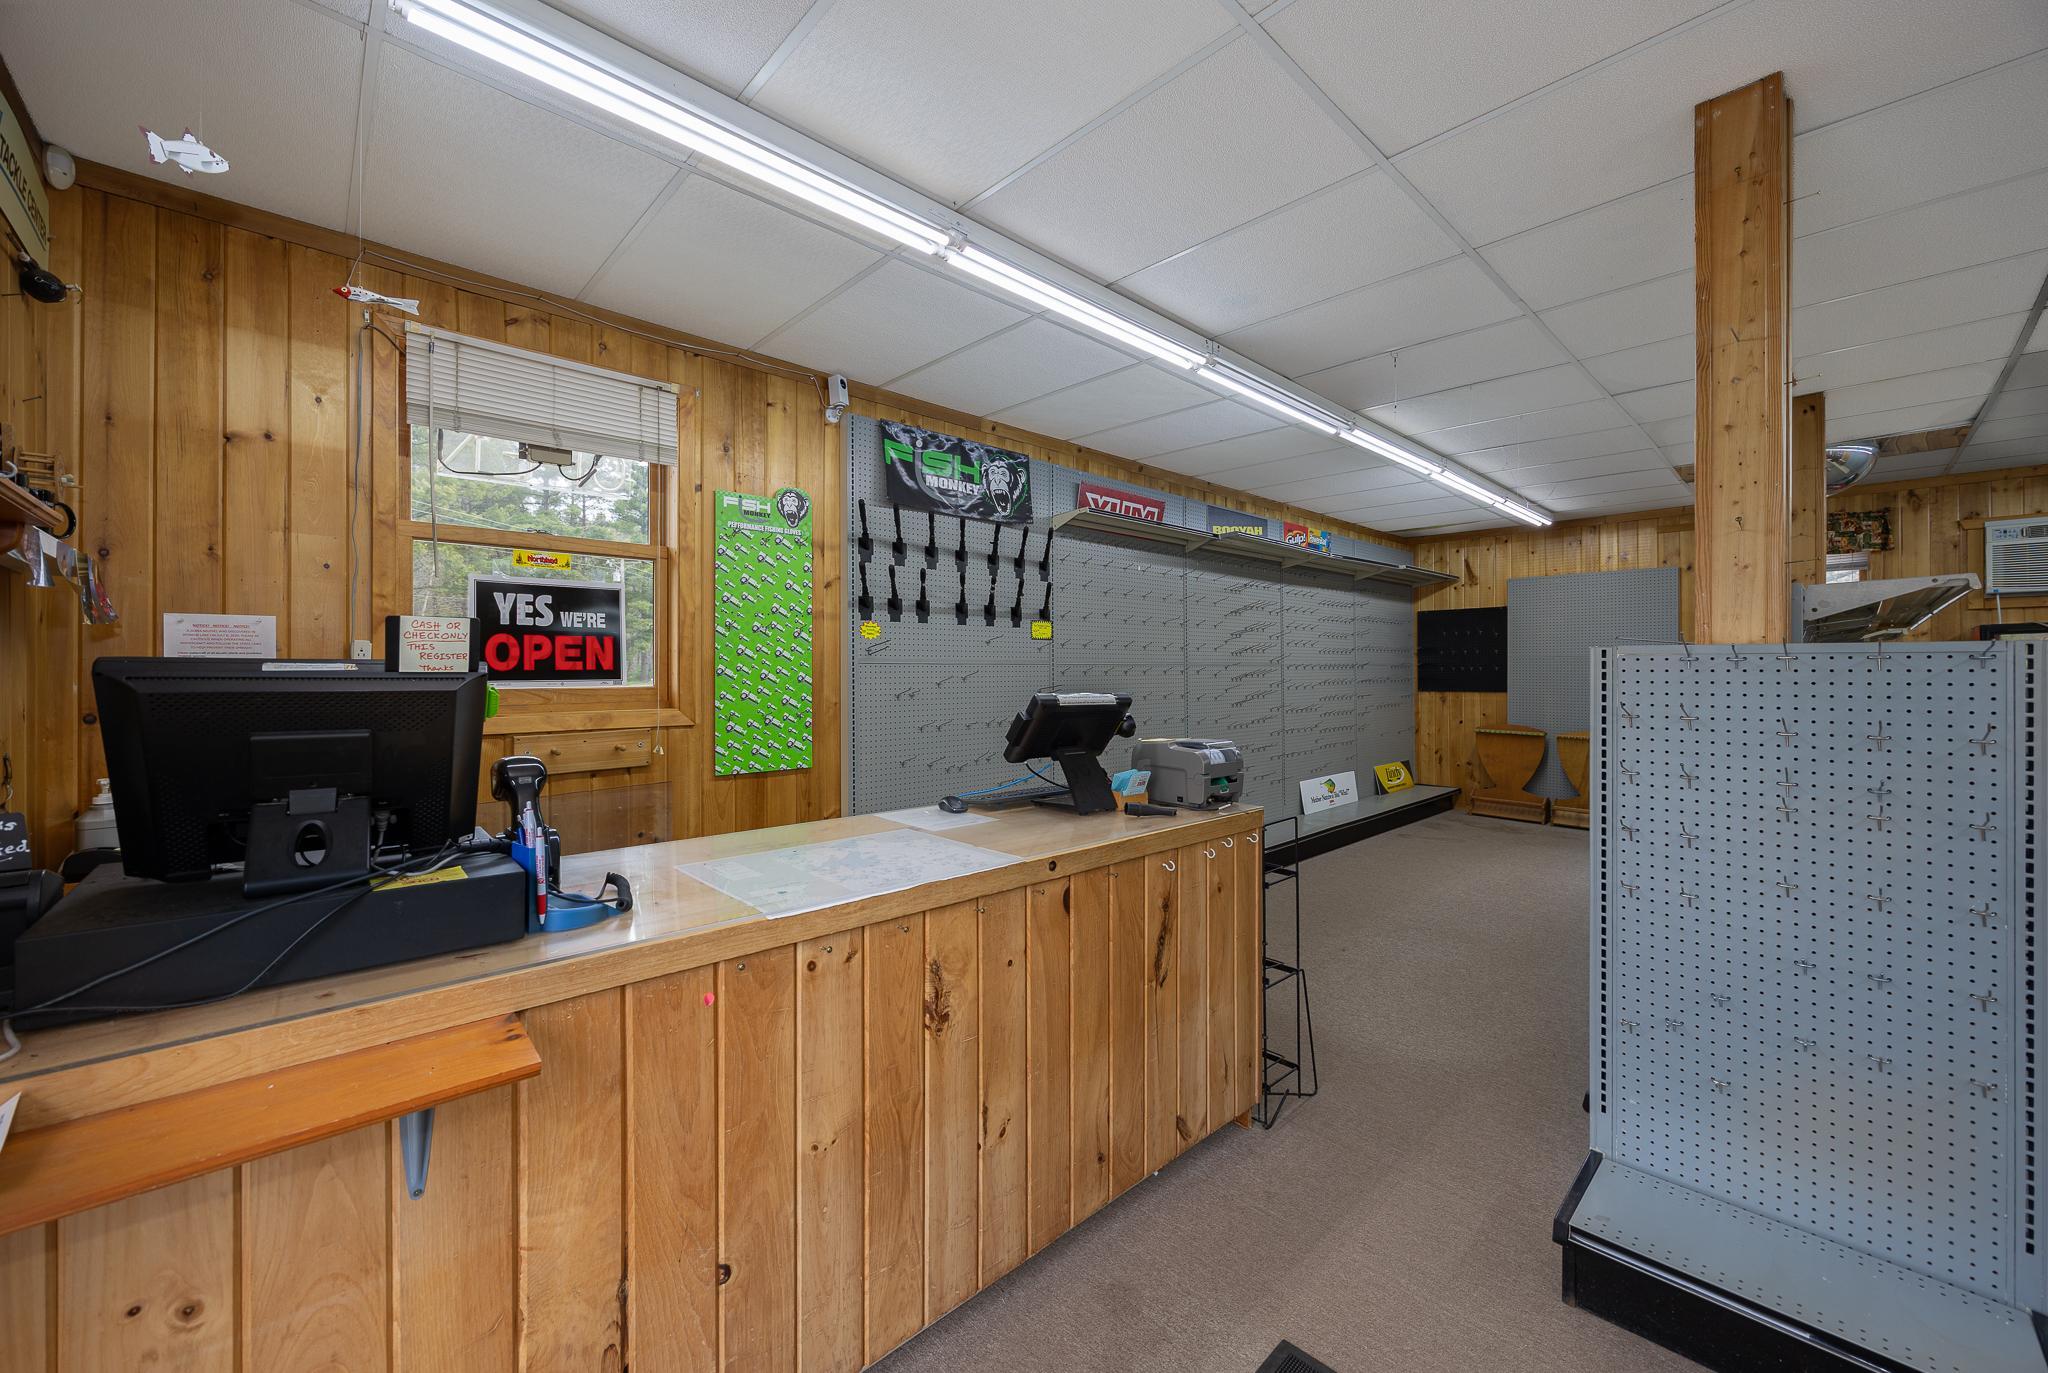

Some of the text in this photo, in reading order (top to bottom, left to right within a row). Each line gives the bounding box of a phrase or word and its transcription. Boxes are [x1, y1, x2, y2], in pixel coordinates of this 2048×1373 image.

[0, 135, 47, 246] TACKLE CENTER
[925, 474, 981, 496] MONKEY
[743, 509, 771, 519] MONKEY
[1212, 525, 1263, 536] BOOYAH
[1286, 533, 1307, 546] Gulp!
[493, 592, 606, 629] YES WE'RE
[411, 619, 461, 631] CASH OR
[403, 630, 468, 640] CHECK ONLY
[407, 643, 436, 651] THIS
[484, 632, 614, 672] OPEN
[419, 652, 468, 661] REGISTER
[419, 664, 454, 672] Thanks
